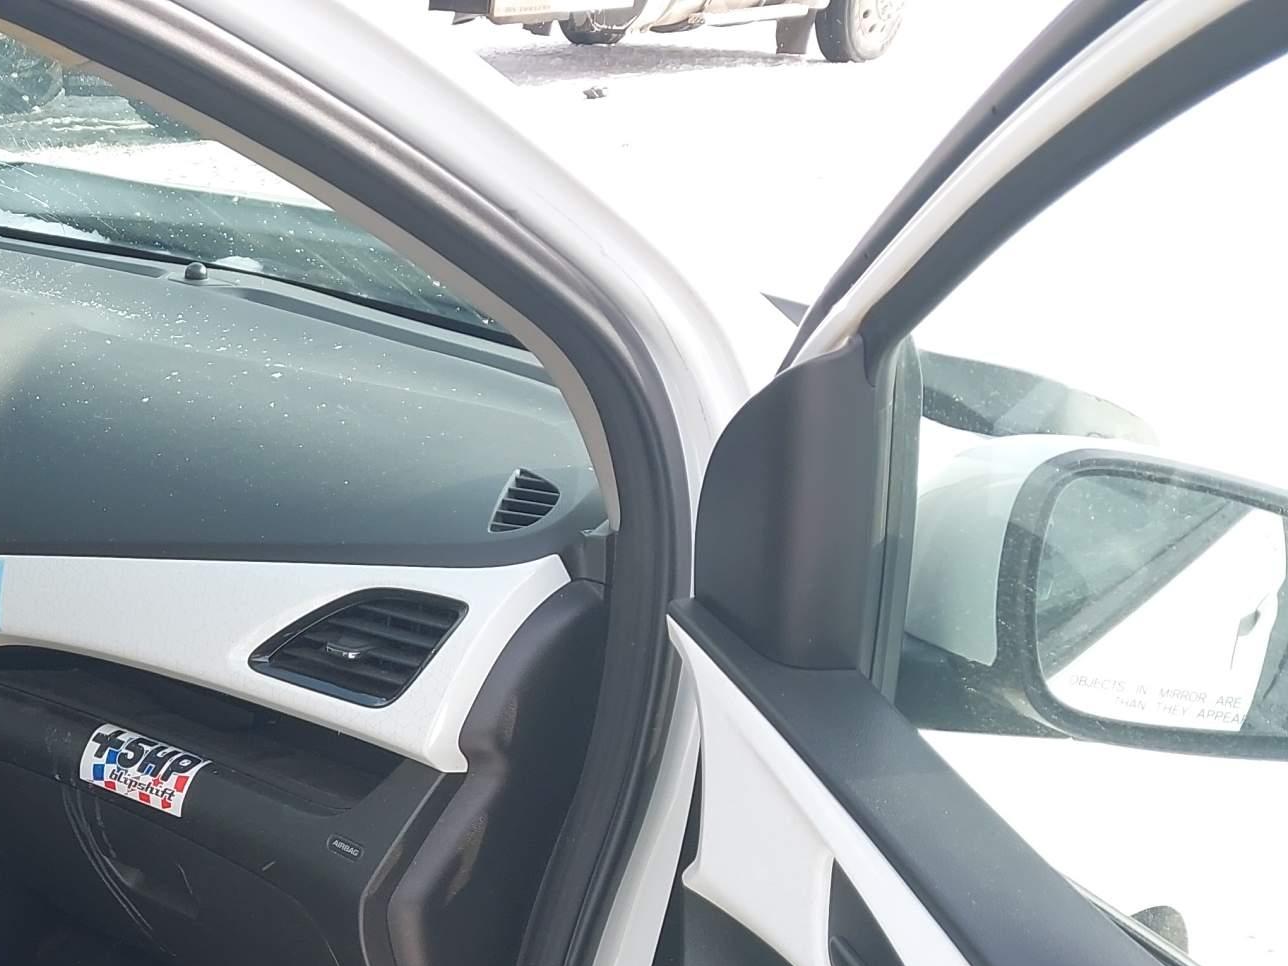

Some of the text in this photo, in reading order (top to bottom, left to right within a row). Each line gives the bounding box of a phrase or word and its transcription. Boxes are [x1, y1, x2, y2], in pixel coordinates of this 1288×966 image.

[1069, 674, 1242, 709] OBJECTS IN MIRROR ARE
[1156, 701, 1189, 718] THEY
[92, 730, 201, 782] +5HP
[109, 768, 175, 802] blipshift
[332, 839, 360, 857] AIRBAG
